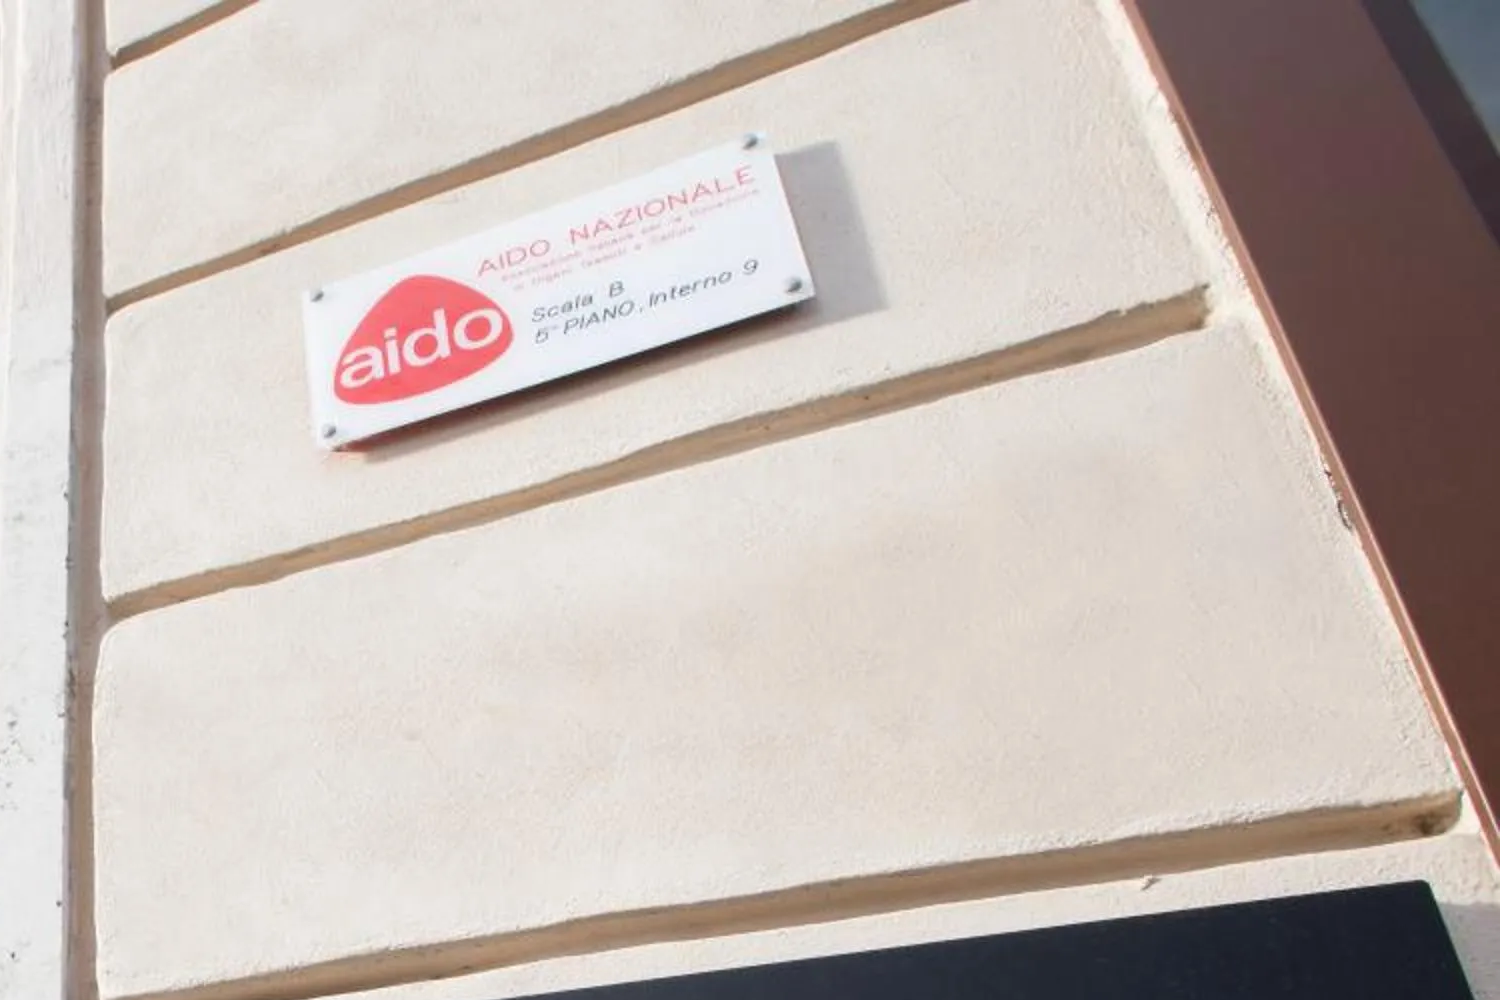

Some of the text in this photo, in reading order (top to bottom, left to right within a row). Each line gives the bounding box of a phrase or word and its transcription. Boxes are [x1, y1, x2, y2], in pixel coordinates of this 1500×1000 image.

[476, 239, 551, 277] AIDO
[569, 165, 757, 245] NAZIONALE
[531, 280, 625, 323] Scala B
[649, 271, 732, 307] Interno
[743, 259, 759, 275] 9
[339, 307, 504, 389] aido
